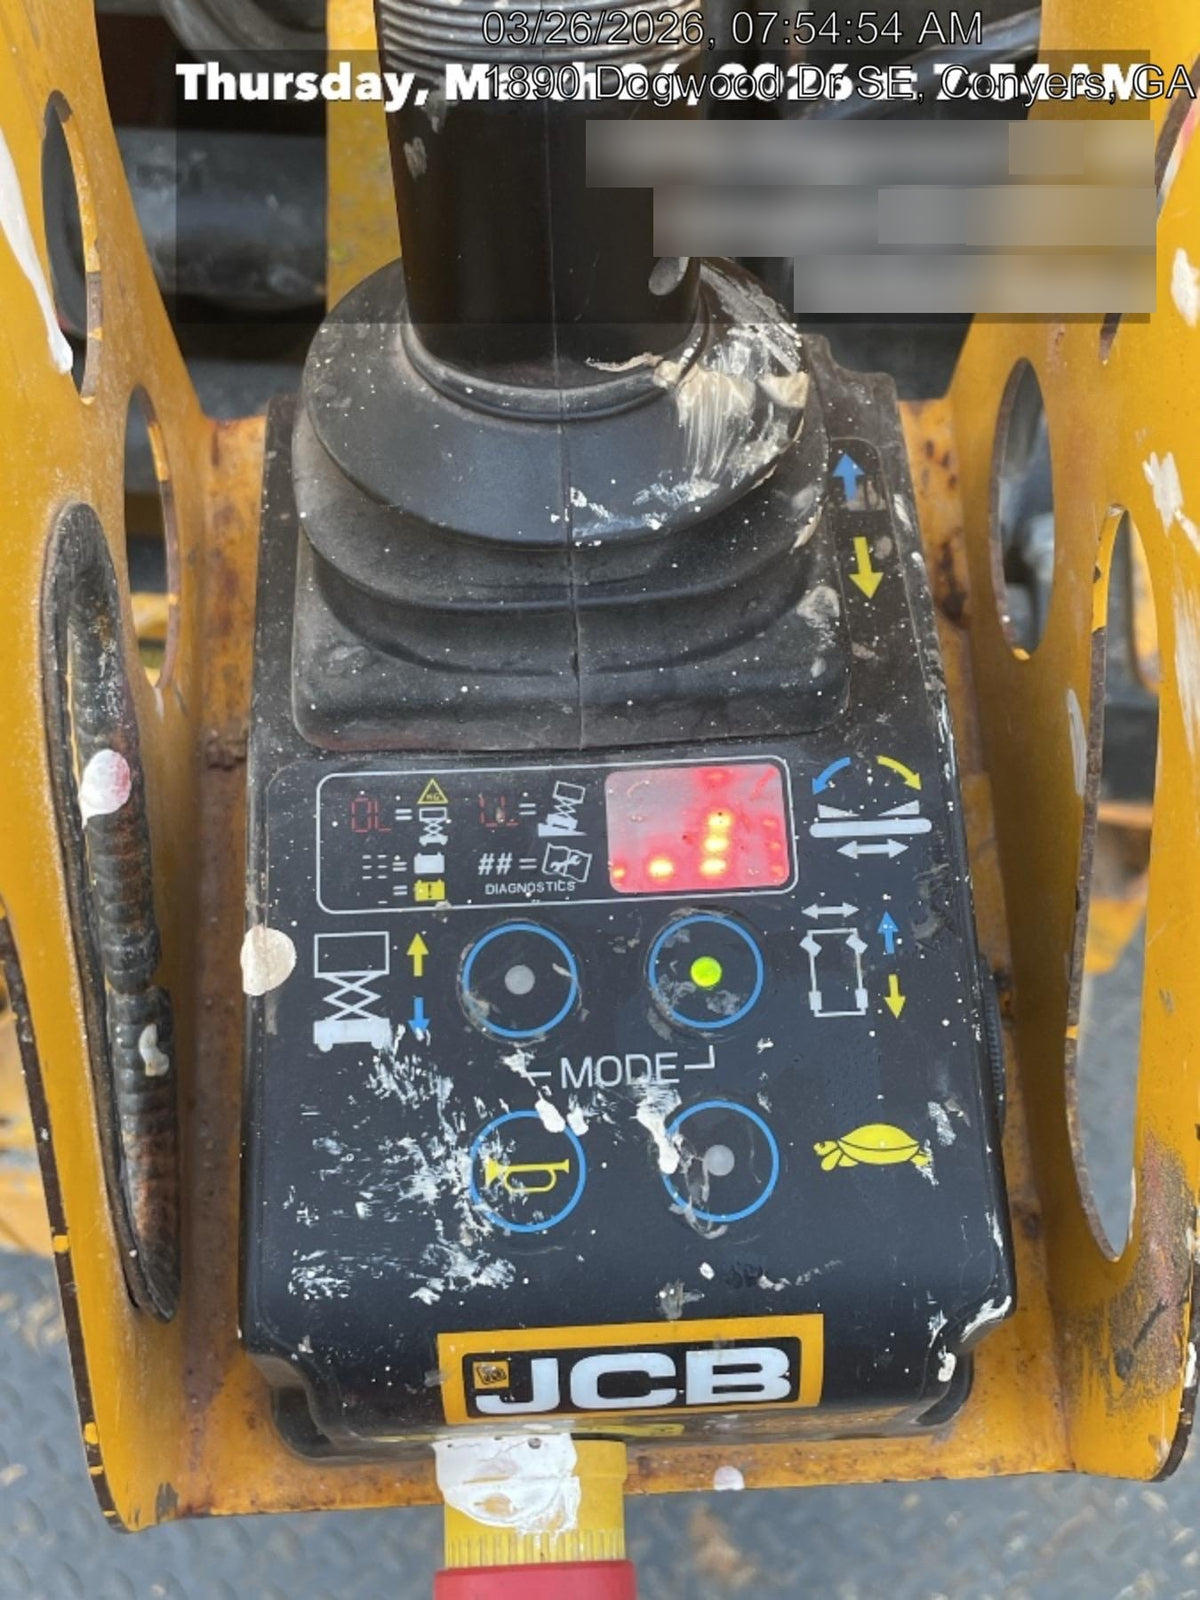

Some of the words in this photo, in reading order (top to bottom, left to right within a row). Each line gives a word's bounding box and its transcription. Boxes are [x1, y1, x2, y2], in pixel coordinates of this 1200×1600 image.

[484, 880, 577, 896] DIAGNOSTICS
[559, 1050, 681, 1090] MODE
[474, 1346, 793, 1416] JCB
